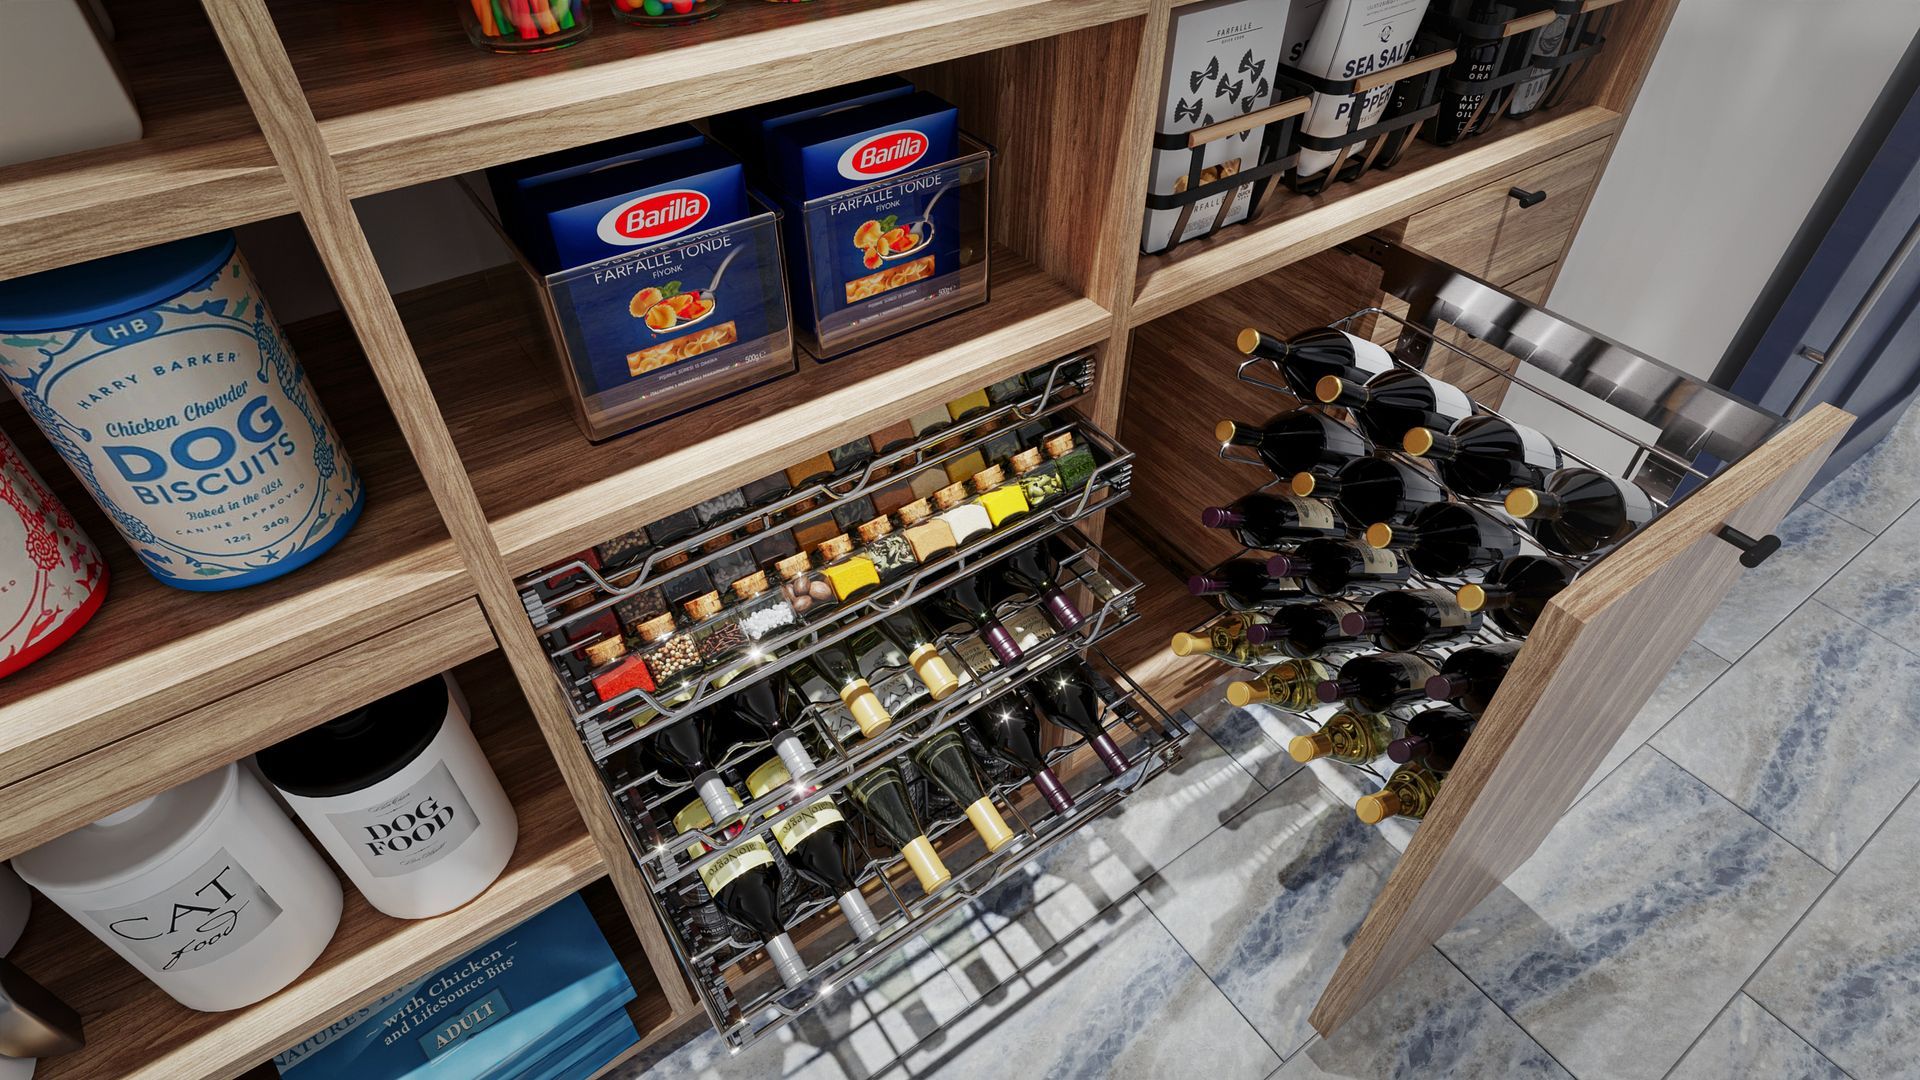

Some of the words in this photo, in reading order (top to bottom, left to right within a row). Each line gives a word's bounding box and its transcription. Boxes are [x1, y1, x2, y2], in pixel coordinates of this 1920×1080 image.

[1217, 22, 1252, 37] FARFALLE
[1343, 54, 1374, 79] SEA
[1378, 39, 1412, 69] SALT
[1335, 85, 1393, 121] PPPER
[1459, 102, 1478, 110] WAT
[859, 136, 921, 169] Barilla
[626, 197, 701, 234] Barilla
[830, 187, 893, 216] FARFALLE
[899, 173, 942, 196] TONDE
[594, 252, 673, 285] FARFALLE
[677, 235, 732, 260] TONDE
[108, 318, 149, 340] HB
[77, 374, 139, 410] HARRY
[153, 352, 238, 377] BARKER
[106, 412, 180, 438] Chicken
[184, 381, 249, 421] Chowder
[101, 395, 284, 482] DOG
[131, 432, 296, 505] BISCUITS
[176, 522, 233, 535] CANINE
[242, 483, 305, 522] APPROVED
[186, 505, 226, 521] Baked
[228, 501, 240, 511] in
[242, 491, 260, 506] the
[261, 478, 284, 496] USA
[262, 515, 290, 532] 340g
[363, 796, 438, 841] DOG
[364, 806, 454, 857] FOOD
[109, 865, 237, 941] CAT
[162, 900, 250, 970] food
[383, 996, 427, 1028] with
[428, 950, 503, 997] Chicken
[384, 1020, 411, 1046] and
[411, 975, 485, 1026] LifeSource
[436, 1000, 496, 1050] ADULT
